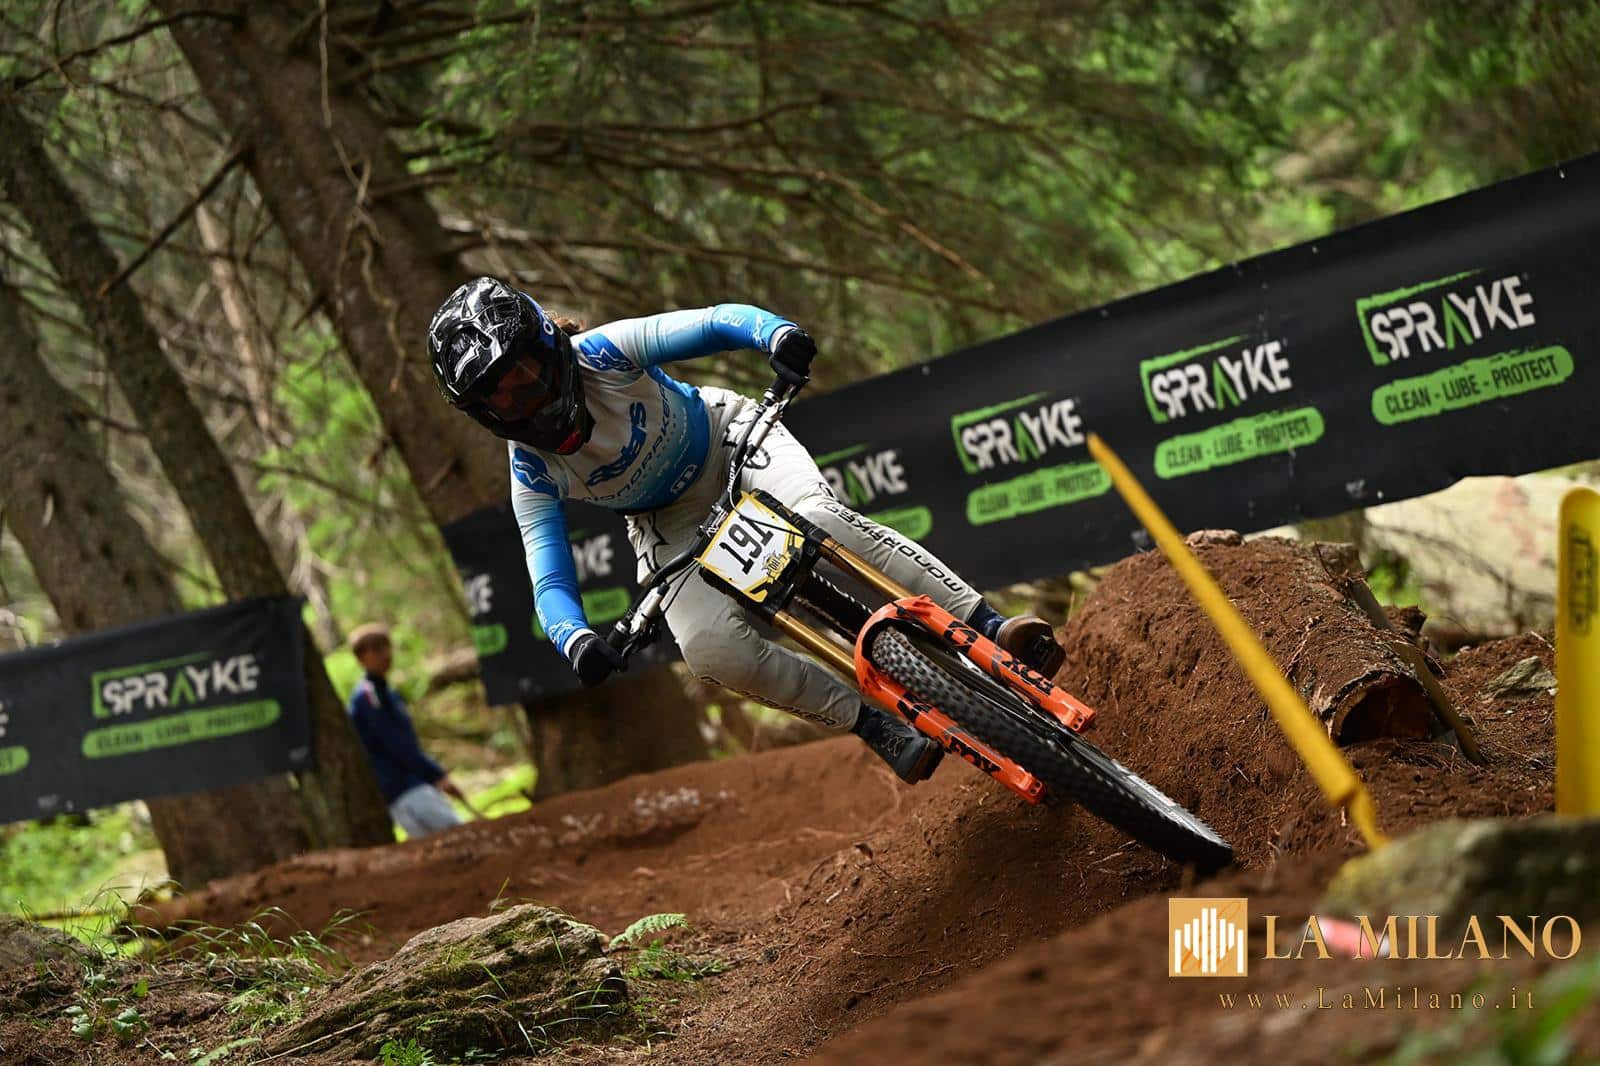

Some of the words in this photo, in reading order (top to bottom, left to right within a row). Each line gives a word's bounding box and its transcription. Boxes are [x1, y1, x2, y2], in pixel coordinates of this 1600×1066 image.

[1371, 275, 1536, 362] SPRAYKE
[1151, 341, 1293, 418] SPRAYKE
[1384, 384, 1432, 416] CLEAN
[1442, 375, 1482, 402] LUBE
[1491, 354, 1560, 391] PROTECT
[961, 399, 1084, 469] SPRAYKE
[1165, 442, 1202, 469] CLEAN
[1213, 434, 1244, 459] LUBE
[1255, 417, 1313, 450] PROTECT
[822, 450, 909, 507] RAYKE
[719, 515, 774, 575] 191
[103, 654, 260, 715] SPRAYKE
